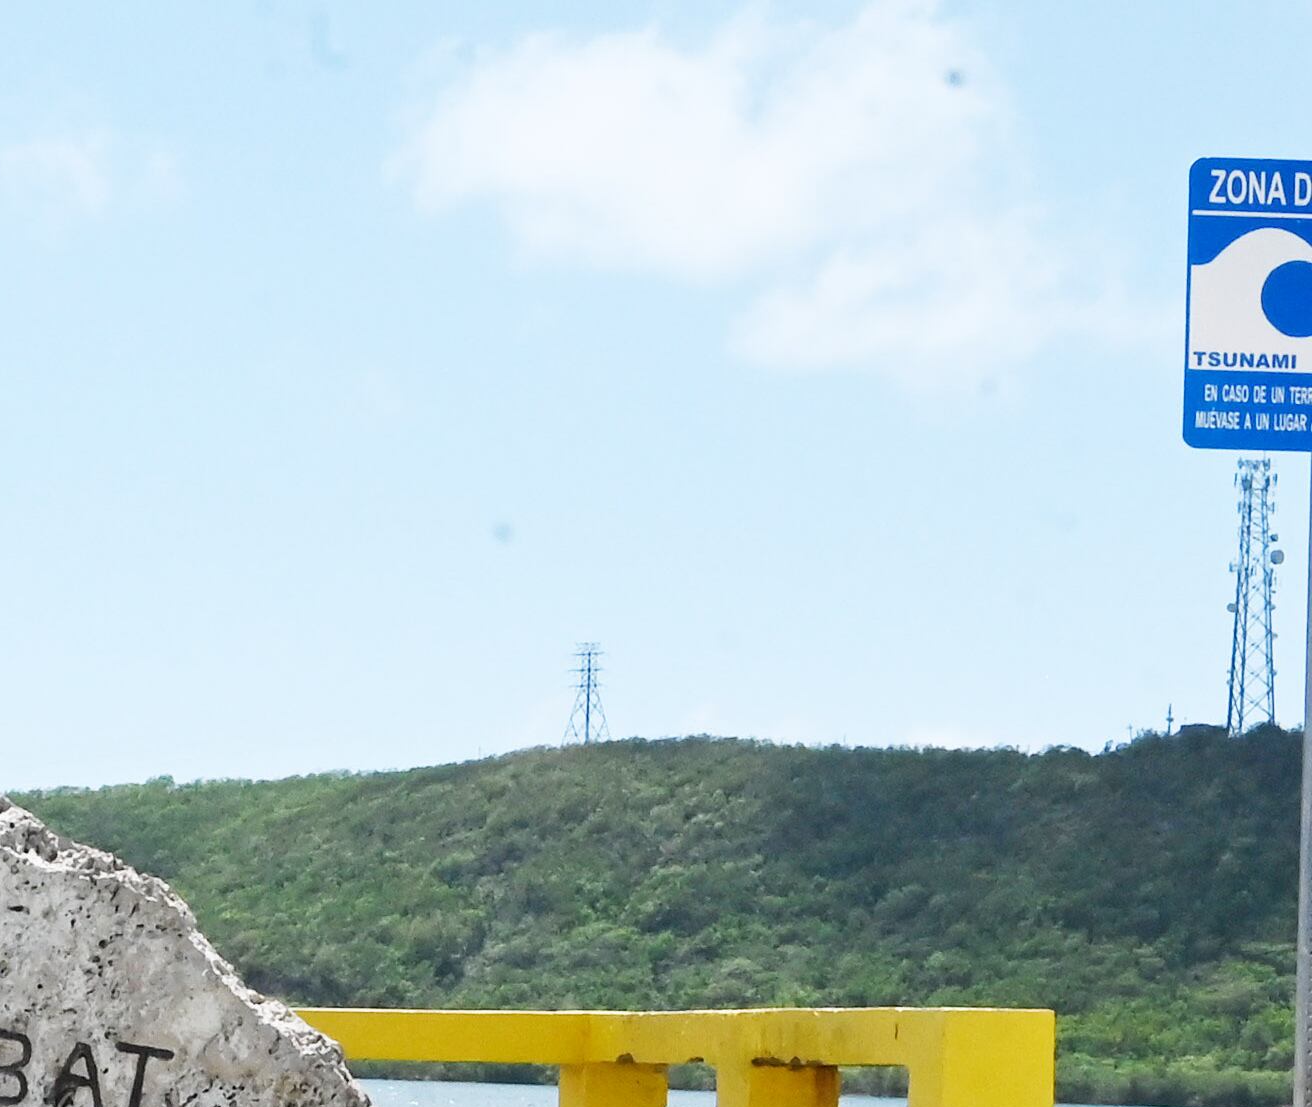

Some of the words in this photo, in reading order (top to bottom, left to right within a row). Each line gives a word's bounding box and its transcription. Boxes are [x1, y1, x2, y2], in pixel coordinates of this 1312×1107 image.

[1209, 168, 1287, 206] ZONA
[1193, 351, 1297, 369] TSUNAMI
[1204, 383, 1218, 402] EN
[1222, 384, 1249, 403] CASO
[1253, 385, 1267, 403] DE
[1271, 386, 1285, 404] UN
[1195, 406, 1240, 430] MUÉVASE
[1244, 412, 1252, 430] A
[1256, 413, 1270, 431] UN
[1274, 413, 1307, 432] LUGAR
